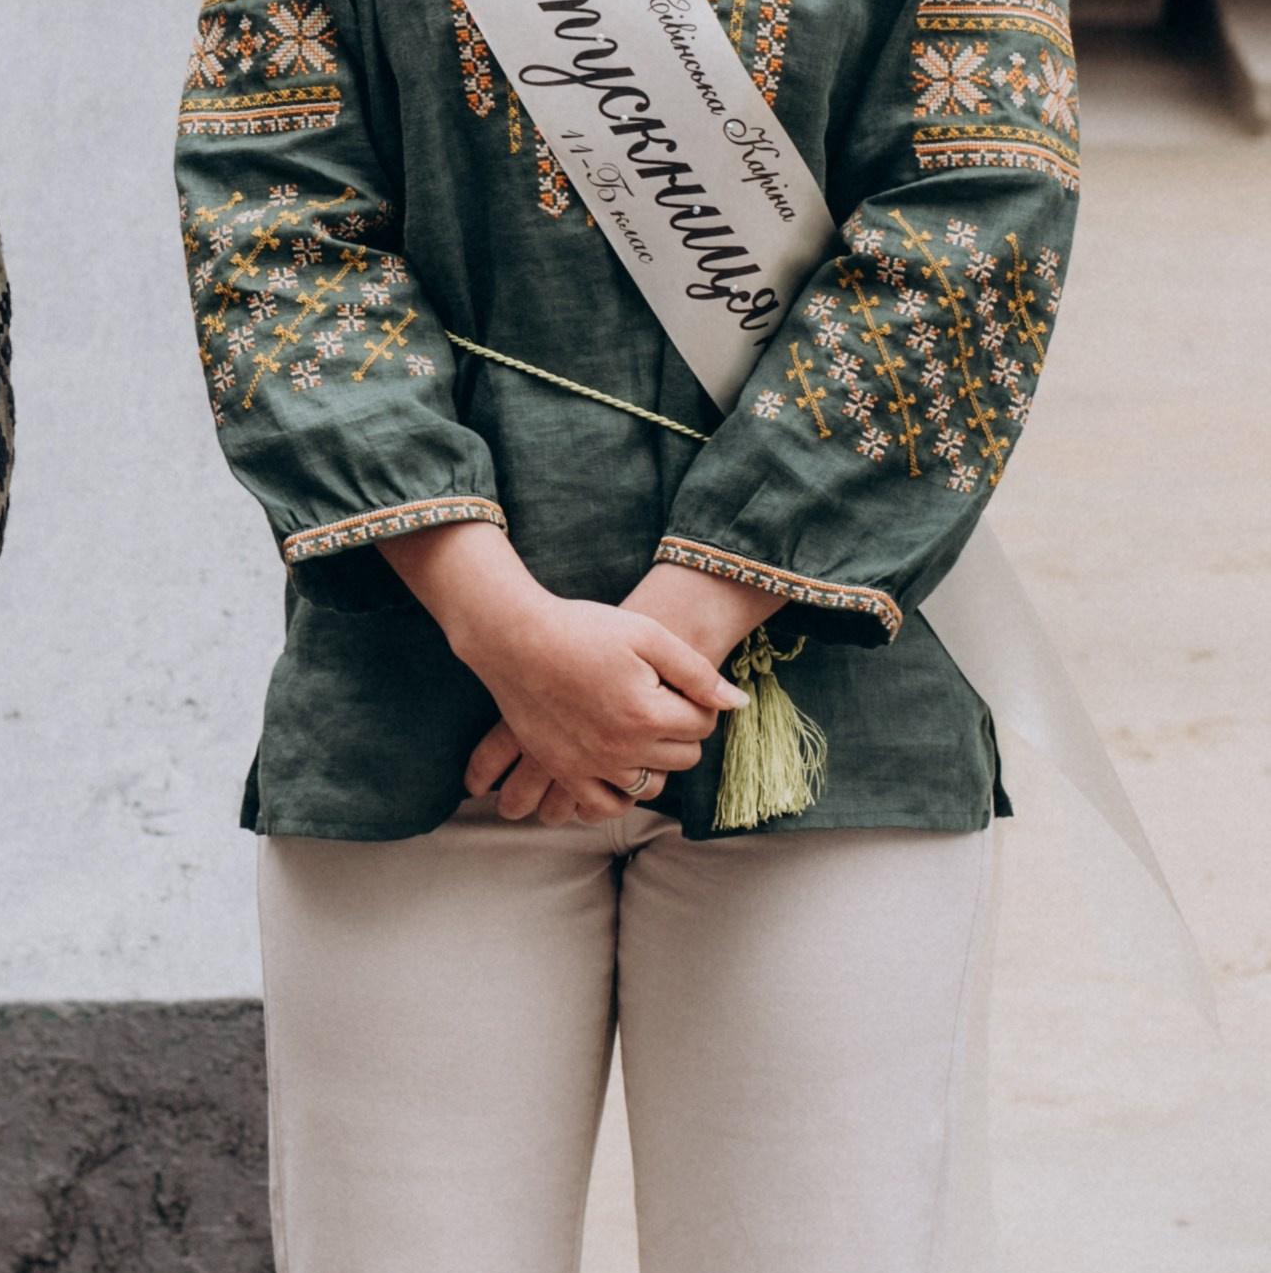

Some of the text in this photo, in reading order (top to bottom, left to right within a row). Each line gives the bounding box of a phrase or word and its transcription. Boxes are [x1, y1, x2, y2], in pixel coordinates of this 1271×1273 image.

[560, 130, 653, 264] 11-Б клас
[723, 118, 796, 222] Каріна
